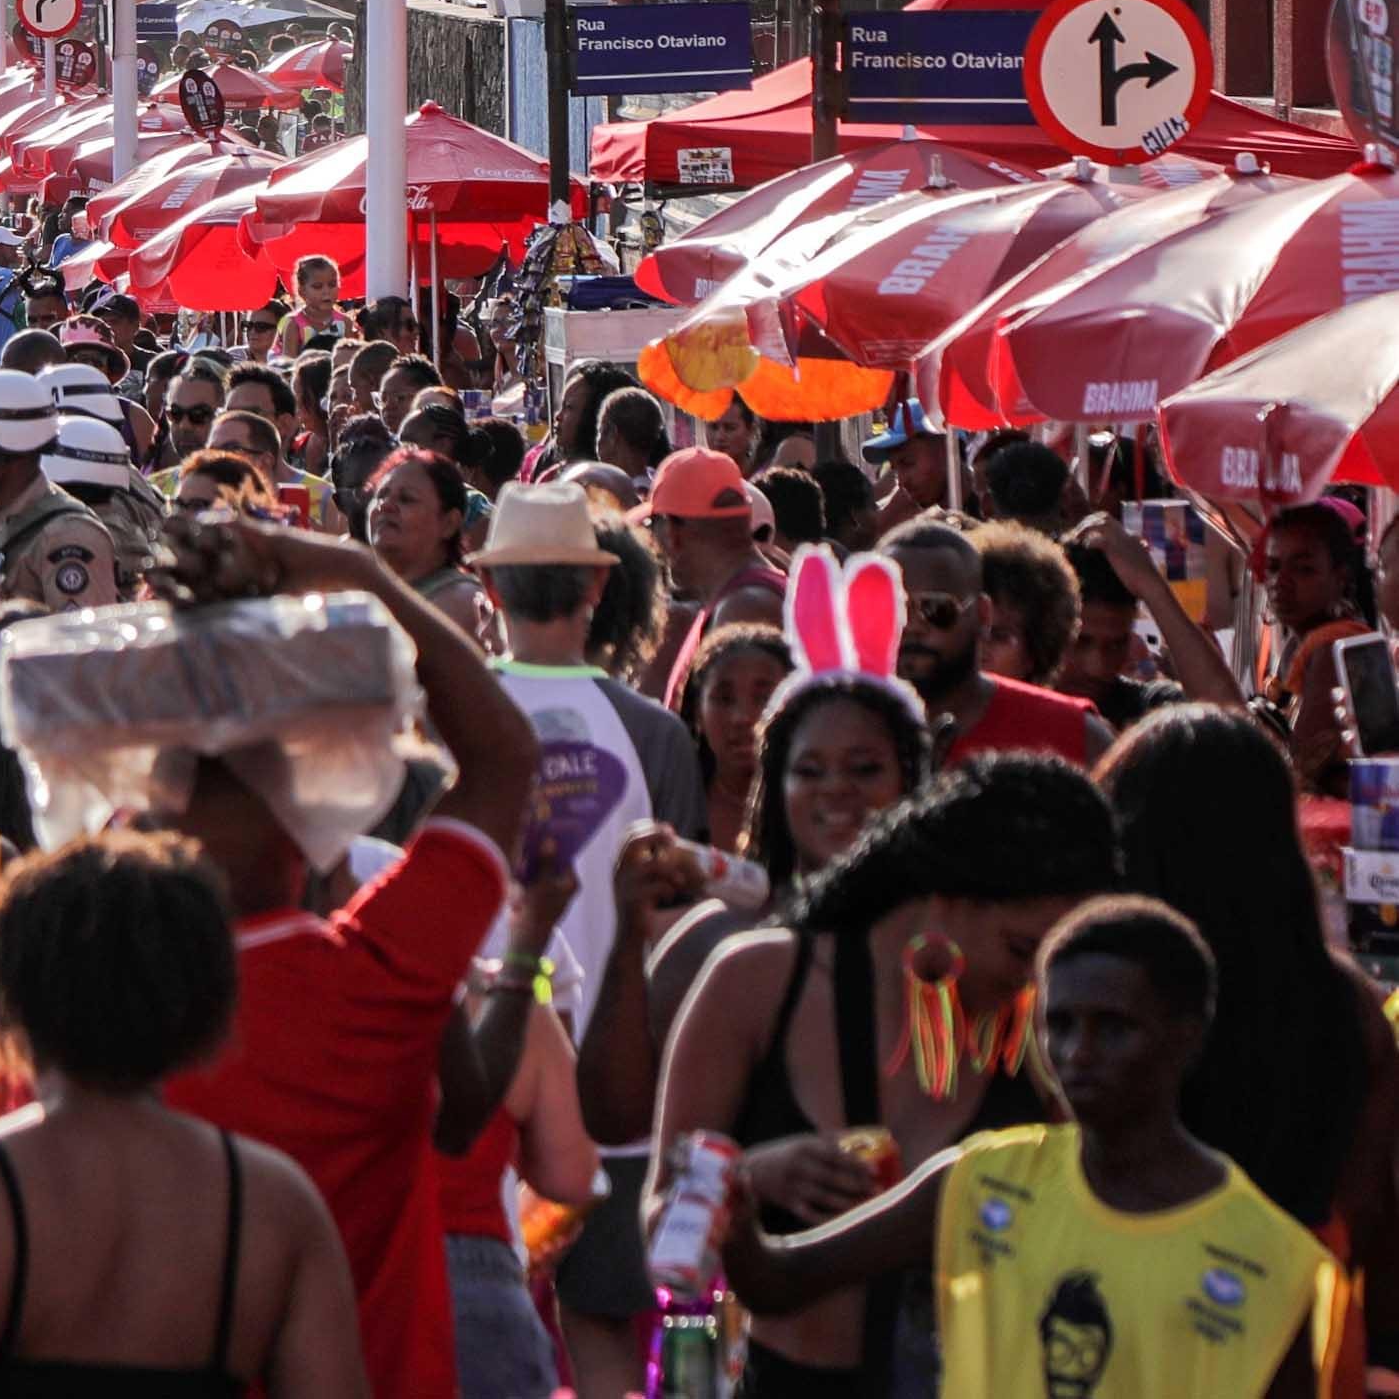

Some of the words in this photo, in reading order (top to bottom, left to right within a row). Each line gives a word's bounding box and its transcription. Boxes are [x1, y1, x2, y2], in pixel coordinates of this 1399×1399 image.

[577, 19, 605, 31] Rua
[852, 27, 888, 42] Rua
[578, 37, 653, 51] Francisco
[657, 35, 726, 48] Otaviano
[852, 52, 947, 69] Francisco
[952, 52, 1024, 69] Otavian
[1084, 380, 1158, 415] BRAHMA
